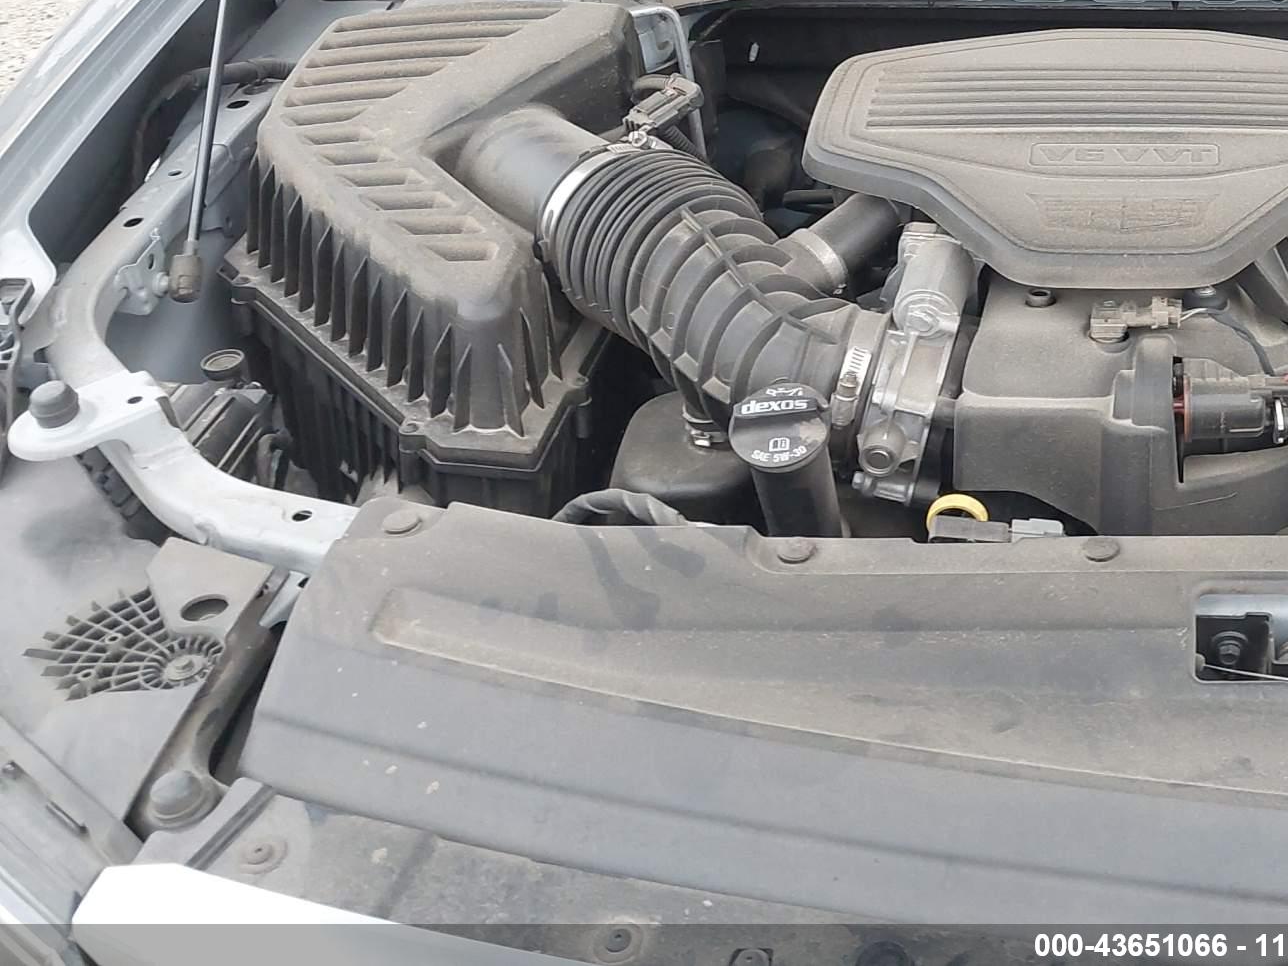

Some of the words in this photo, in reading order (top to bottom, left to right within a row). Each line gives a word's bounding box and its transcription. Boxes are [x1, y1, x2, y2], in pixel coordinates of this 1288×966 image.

[1039, 147, 1104, 163] V6
[1112, 147, 1217, 164] VVT
[741, 399, 811, 415] dexos
[751, 450, 771, 462] SAE
[773, 445, 808, 463] 5W-30
